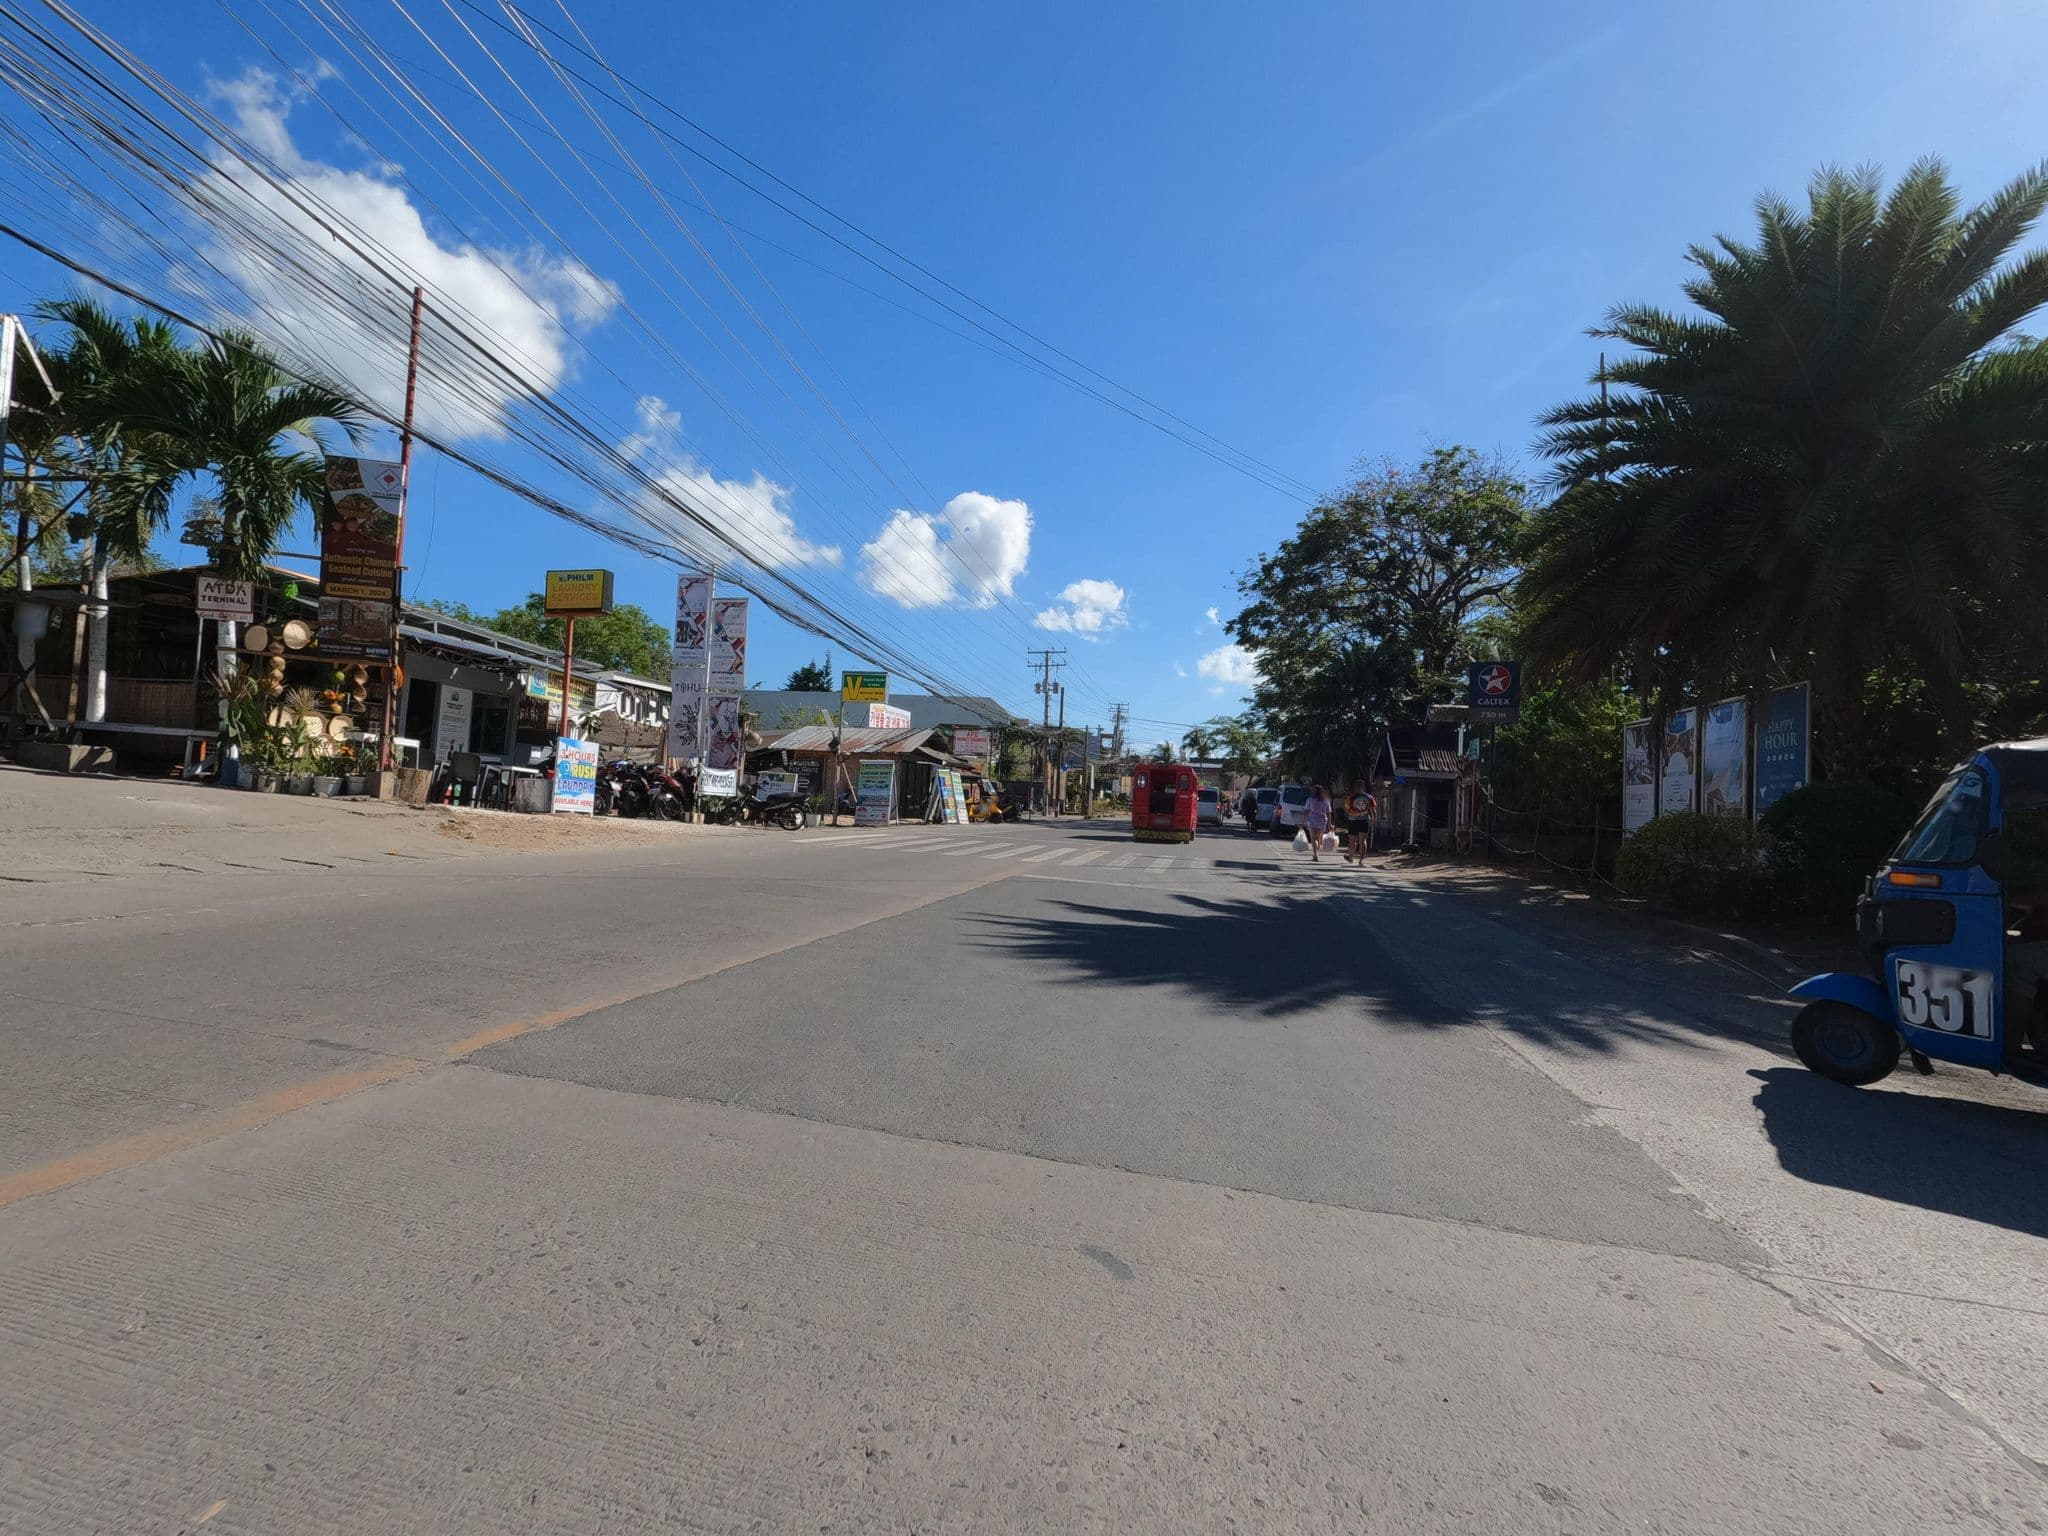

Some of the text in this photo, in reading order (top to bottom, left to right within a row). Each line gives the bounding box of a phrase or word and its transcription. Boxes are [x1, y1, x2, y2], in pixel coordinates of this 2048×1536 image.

[324, 553, 363, 565] Authentic
[328, 563, 393, 578] Seafood Cuisine
[329, 585, 358, 594] MARCH
[552, 583, 597, 592] LAUNDRY
[201, 595, 248, 605] TERMINAL
[1478, 698, 1510, 706] CALTEX
[1480, 711, 1497, 719] 750
[1768, 718, 1794, 734] HAPPY
[1764, 731, 1798, 750] HOUR
[569, 751, 596, 763] HOURS
[572, 763, 597, 779] RUSH
[558, 779, 594, 793] LAUNDRY
[580, 799, 593, 807] HERE
[1900, 962, 1990, 1037] 351
